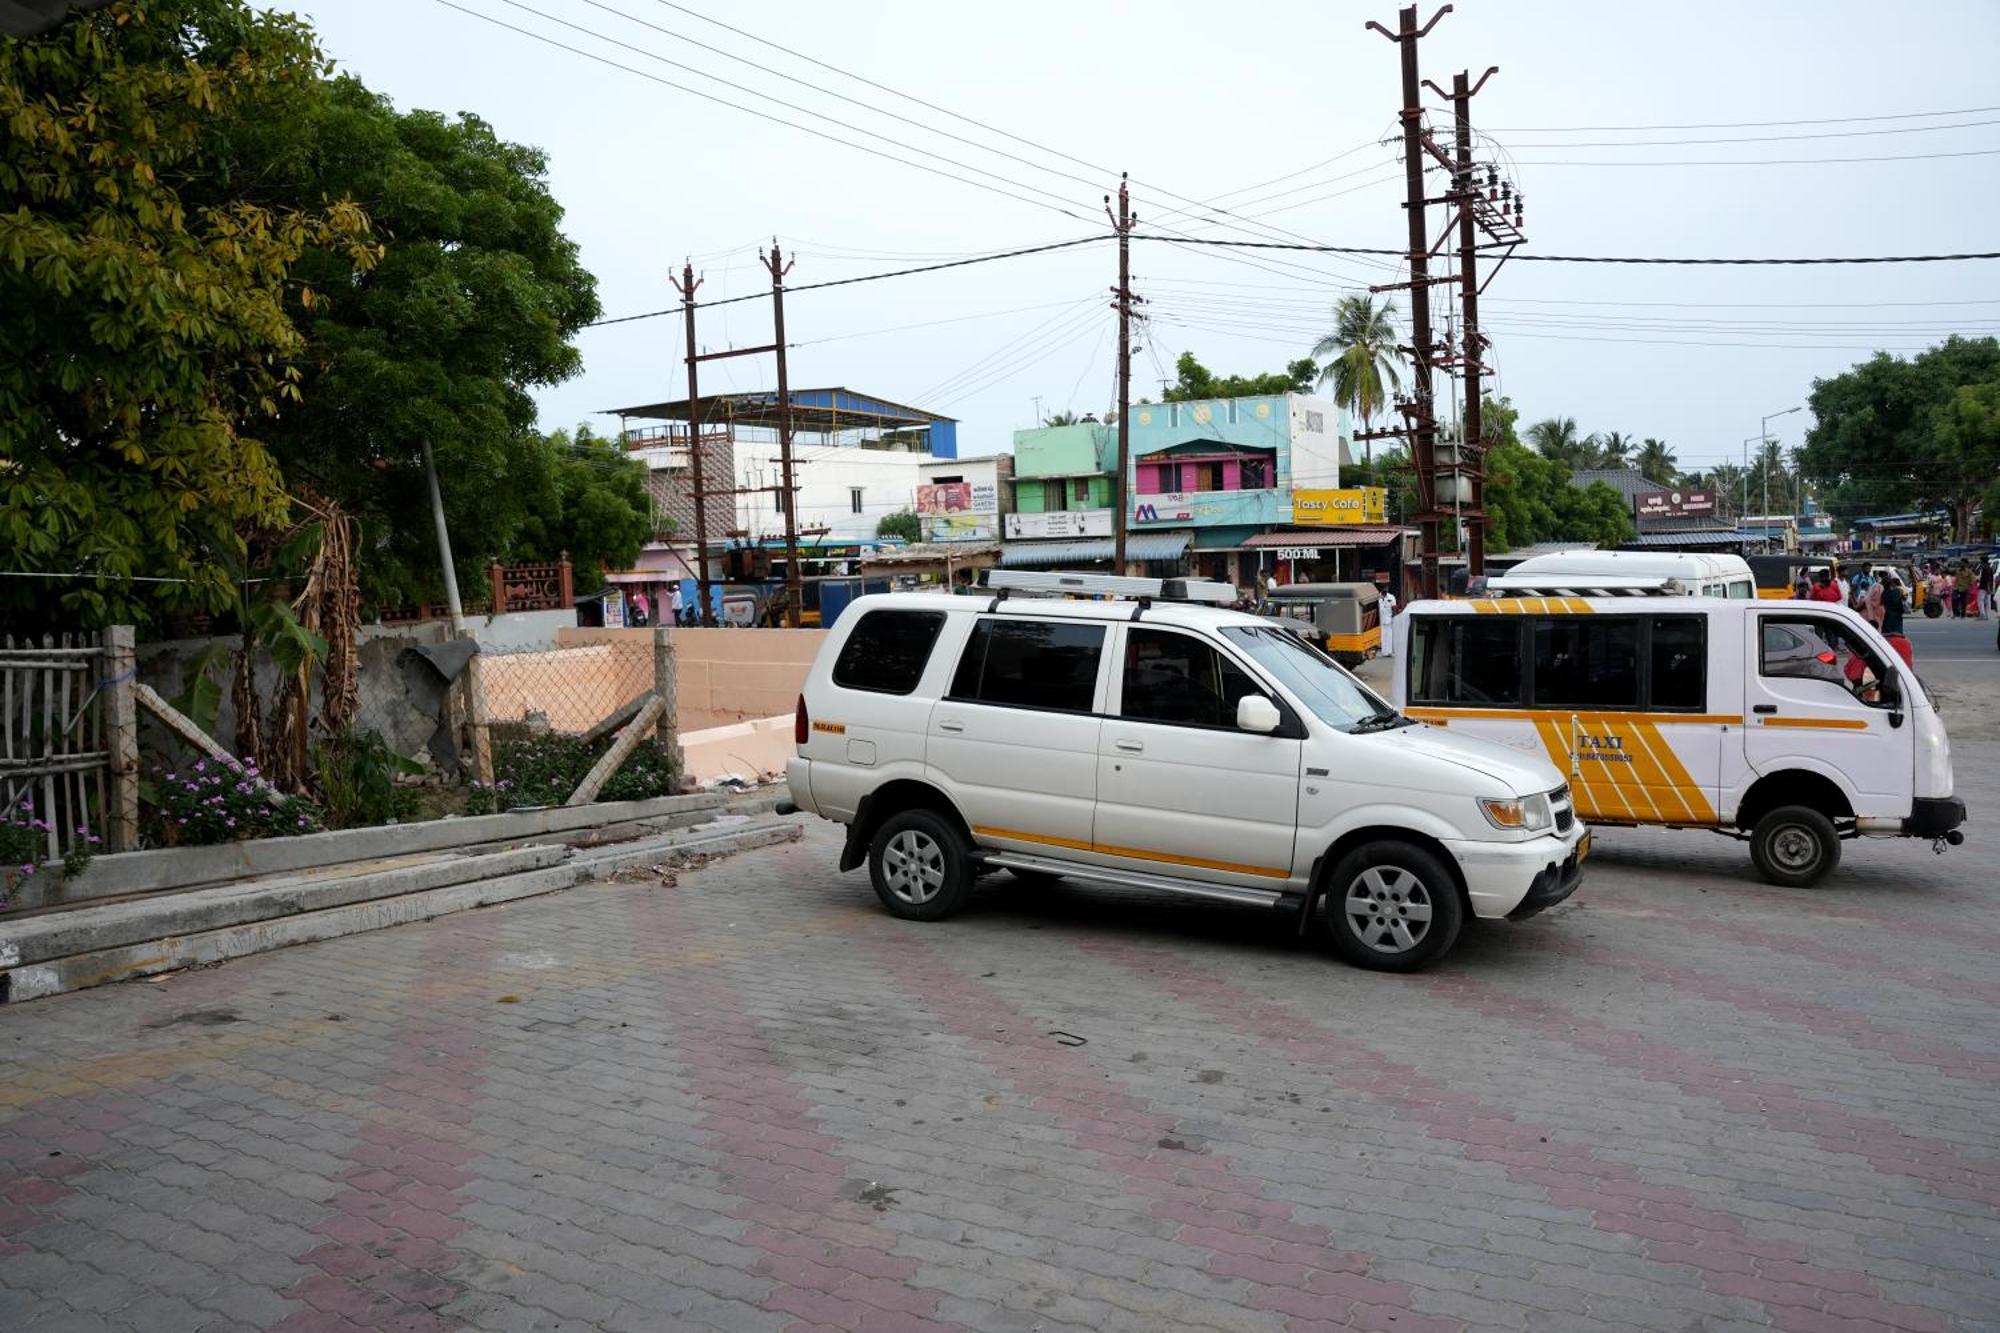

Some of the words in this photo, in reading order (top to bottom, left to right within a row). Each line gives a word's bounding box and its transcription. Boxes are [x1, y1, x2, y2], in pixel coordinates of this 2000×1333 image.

[1295, 497, 1328, 511] Tasty
[1332, 497, 1360, 510] Cafe
[1577, 735, 1623, 749] TAXI
